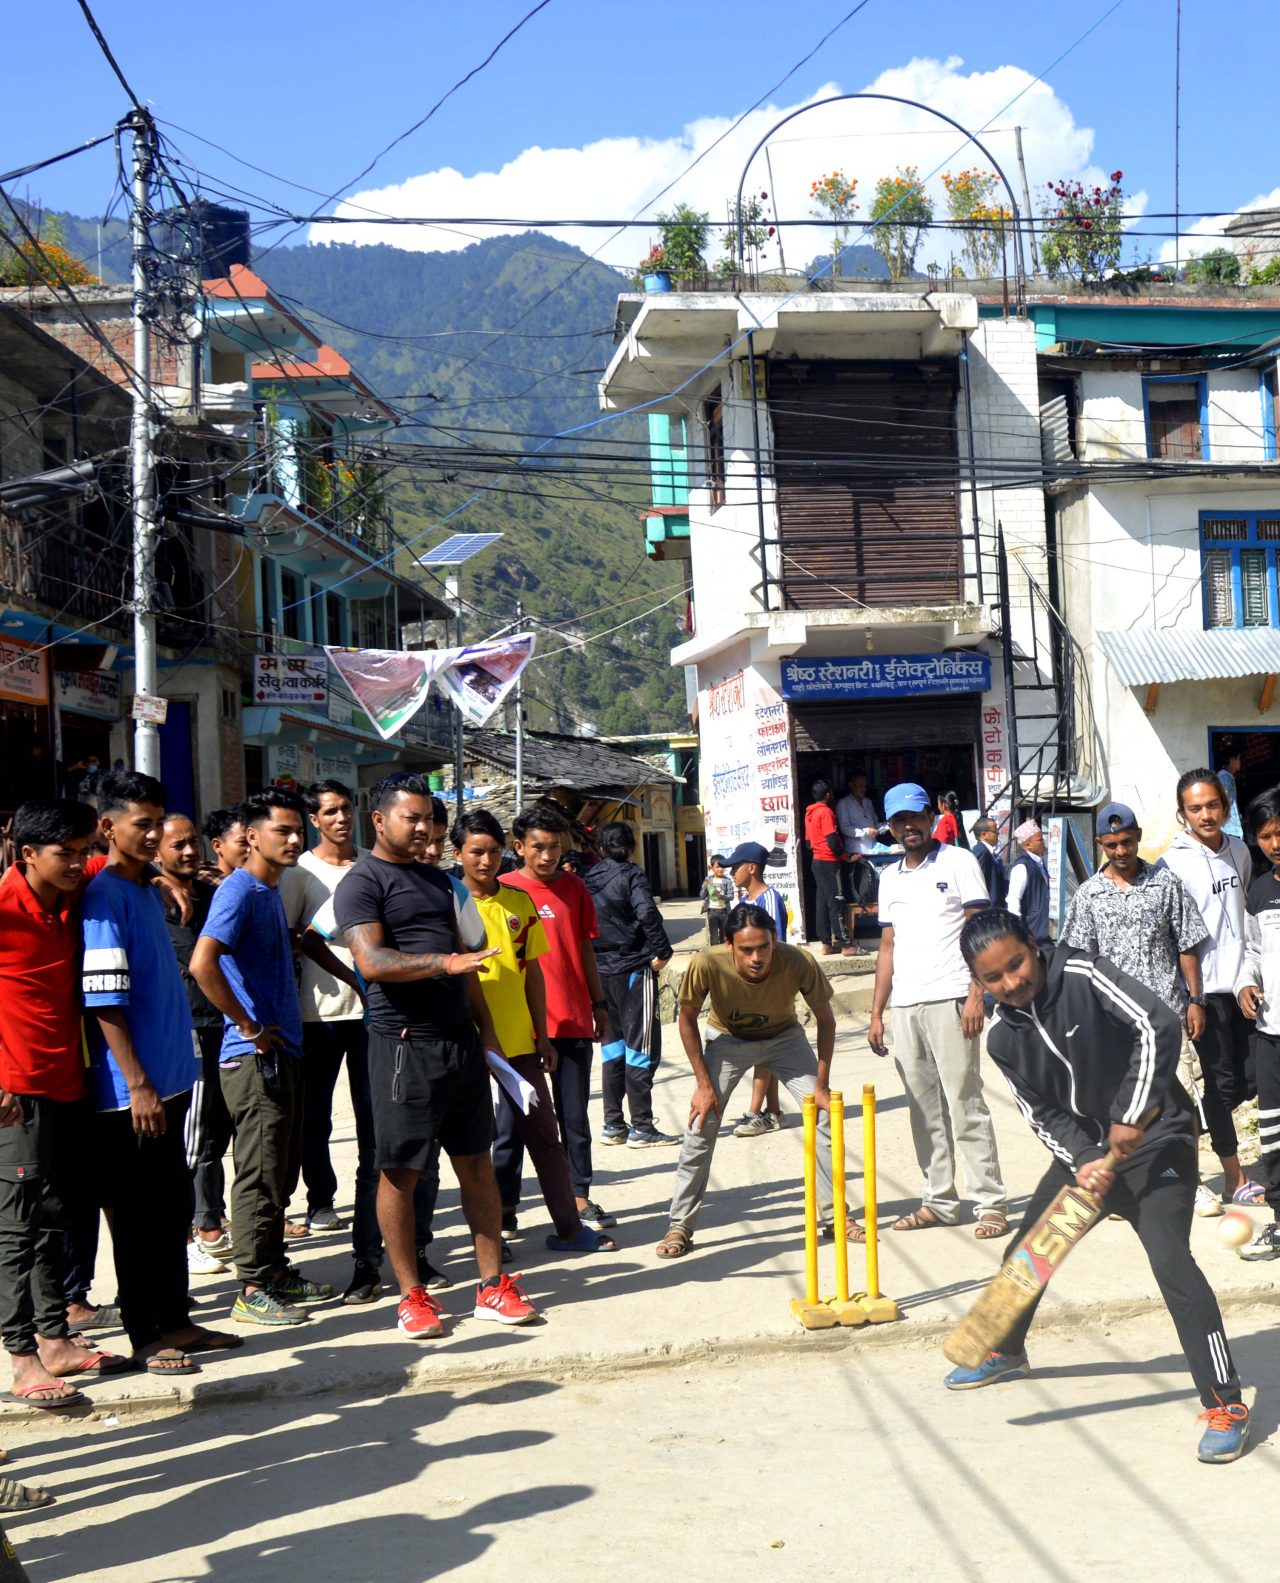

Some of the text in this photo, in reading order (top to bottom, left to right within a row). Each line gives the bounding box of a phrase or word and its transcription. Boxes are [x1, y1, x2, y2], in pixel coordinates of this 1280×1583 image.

[786, 663, 816, 683] श्रेष्ठ
[818, 660, 874, 682] स्टेशनरी
[760, 795, 789, 812] छाप
[1212, 875, 1239, 895] UFC
